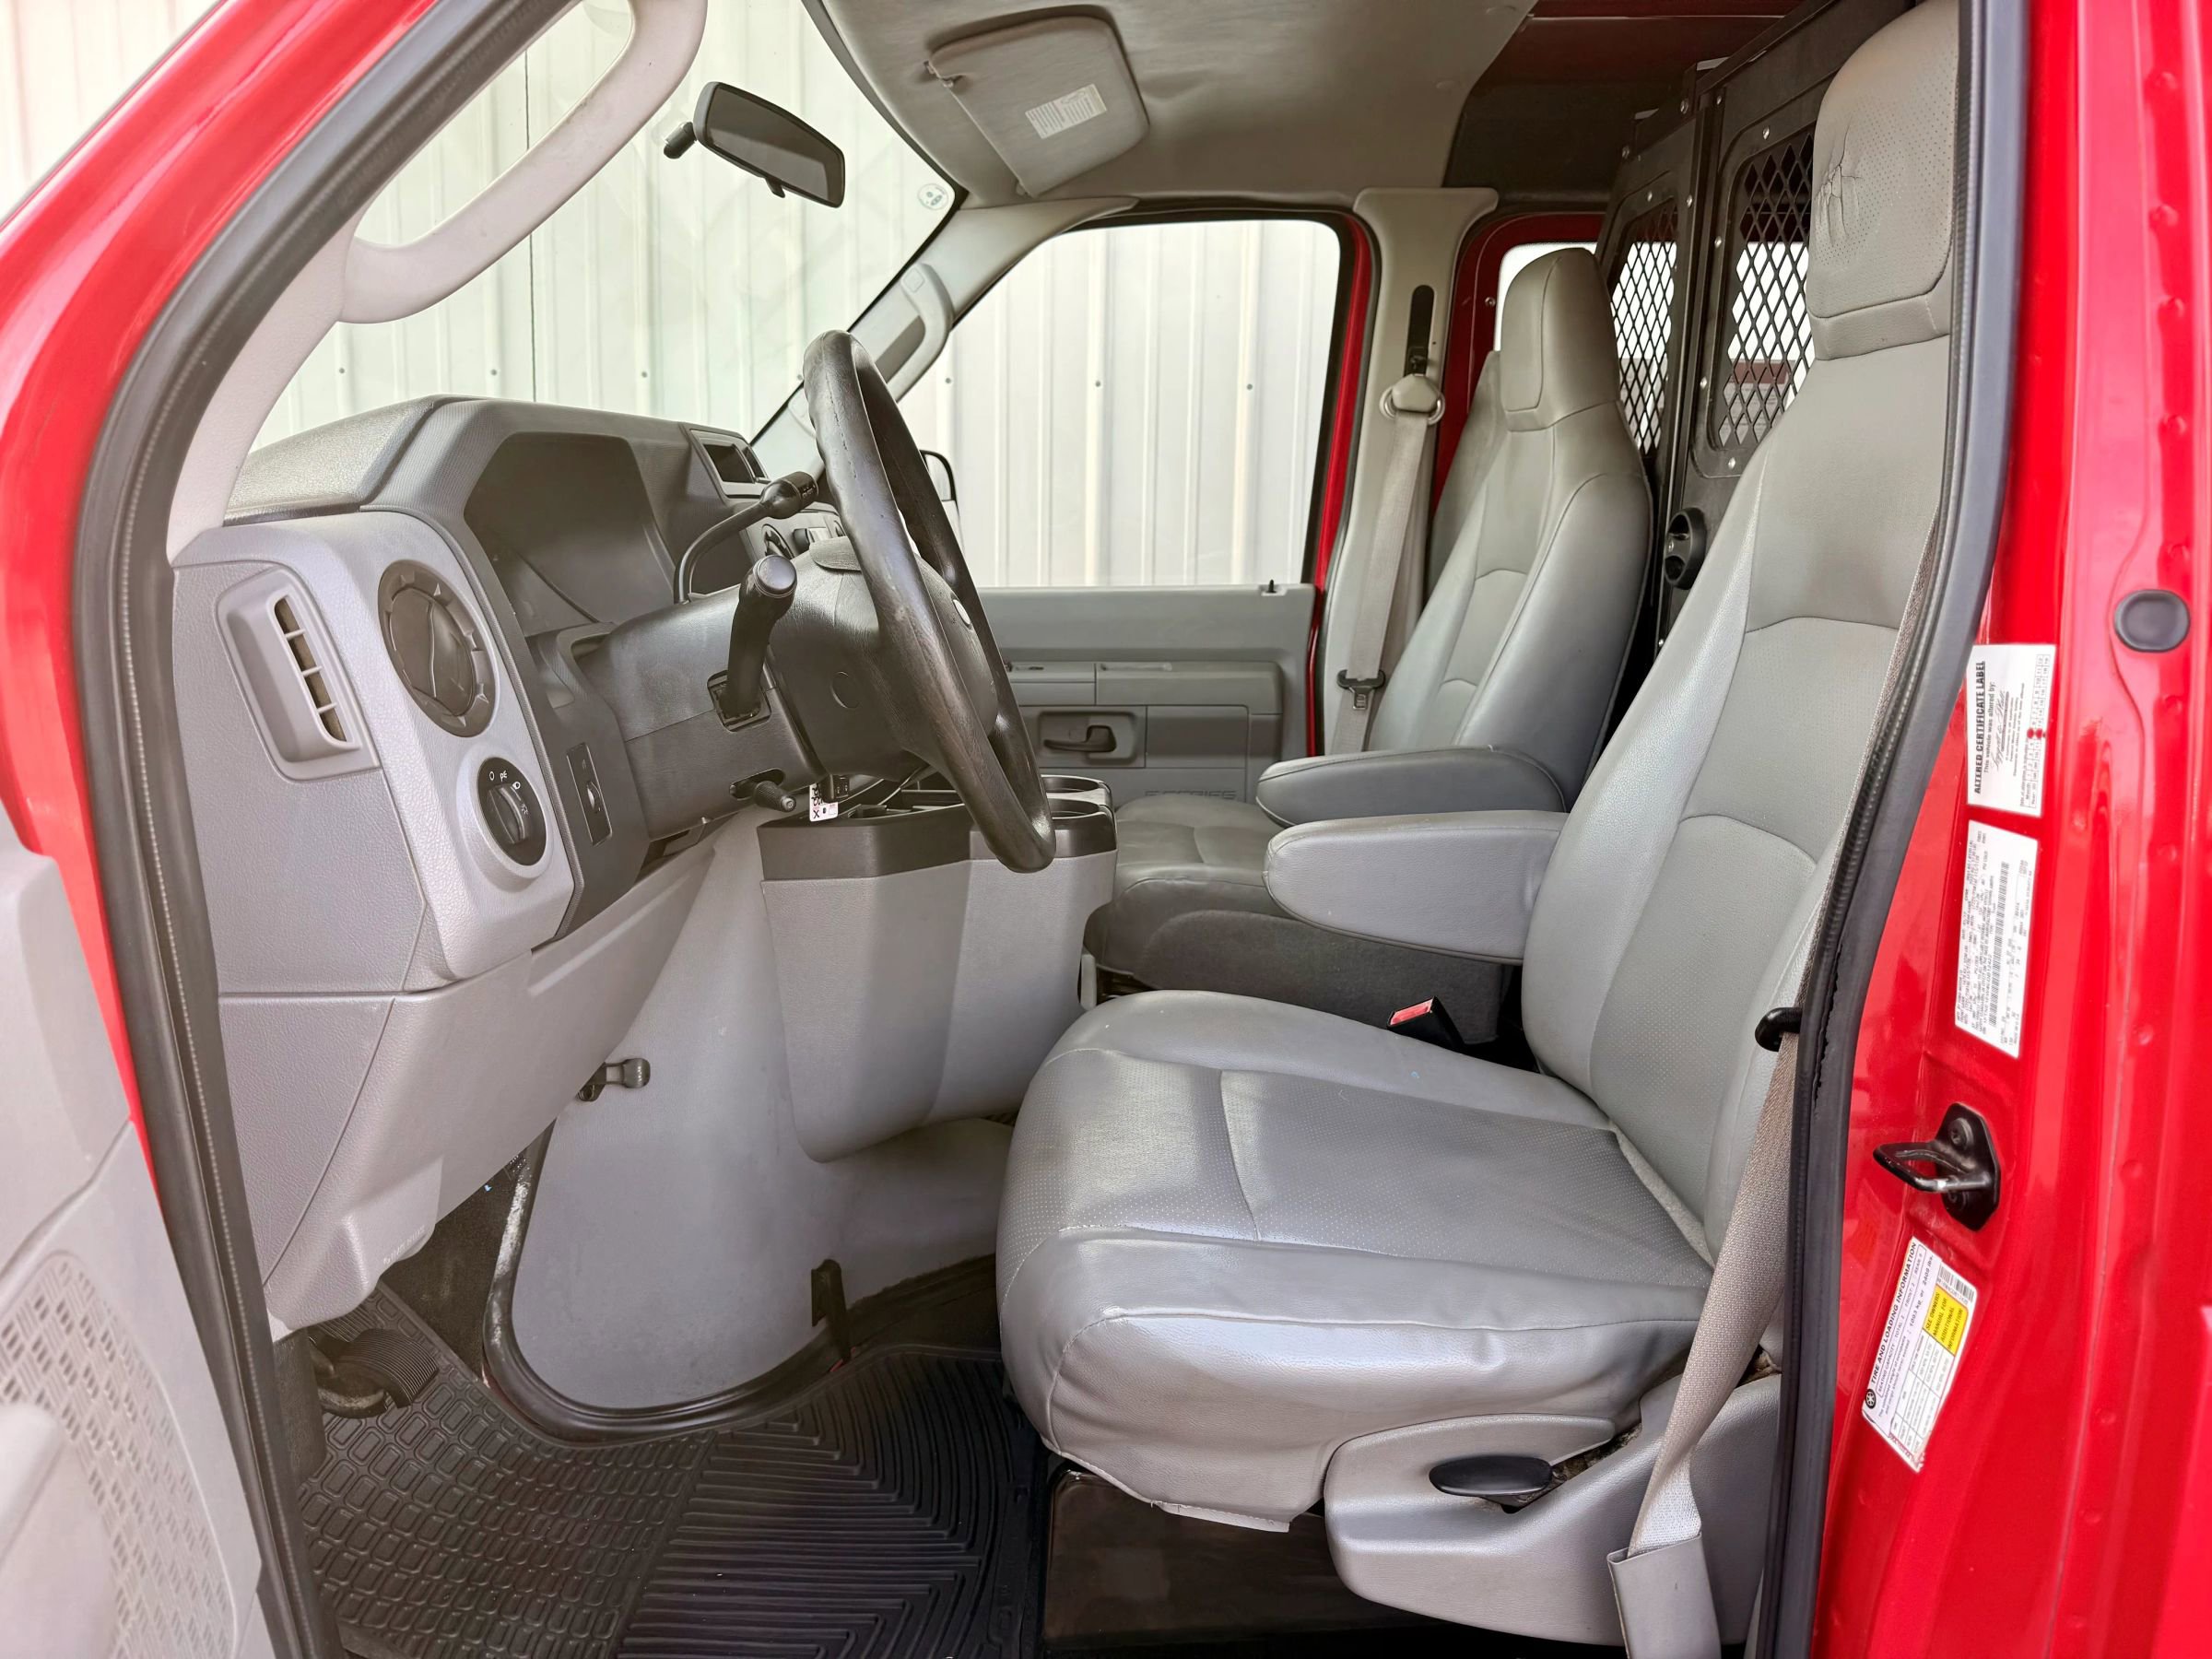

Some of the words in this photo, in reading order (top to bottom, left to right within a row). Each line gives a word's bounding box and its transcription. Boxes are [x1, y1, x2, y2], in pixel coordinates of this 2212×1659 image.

[1975, 661, 1984, 688] LABEL
[1974, 691, 1985, 751] CERTIFICATE
[1870, 1363, 1879, 1384] TIRE
[1877, 1343, 1885, 1363] AND
[1883, 1302, 1898, 1344] LOADING
[1895, 1241, 1916, 1304] INFORMATION
[1928, 1290, 1940, 1319] OWNERS
[1932, 1310, 1943, 1337] MANUAL
[1939, 1304, 1954, 1343] ADDITIONAL
[1946, 1307, 1963, 1351] INFORMATION
